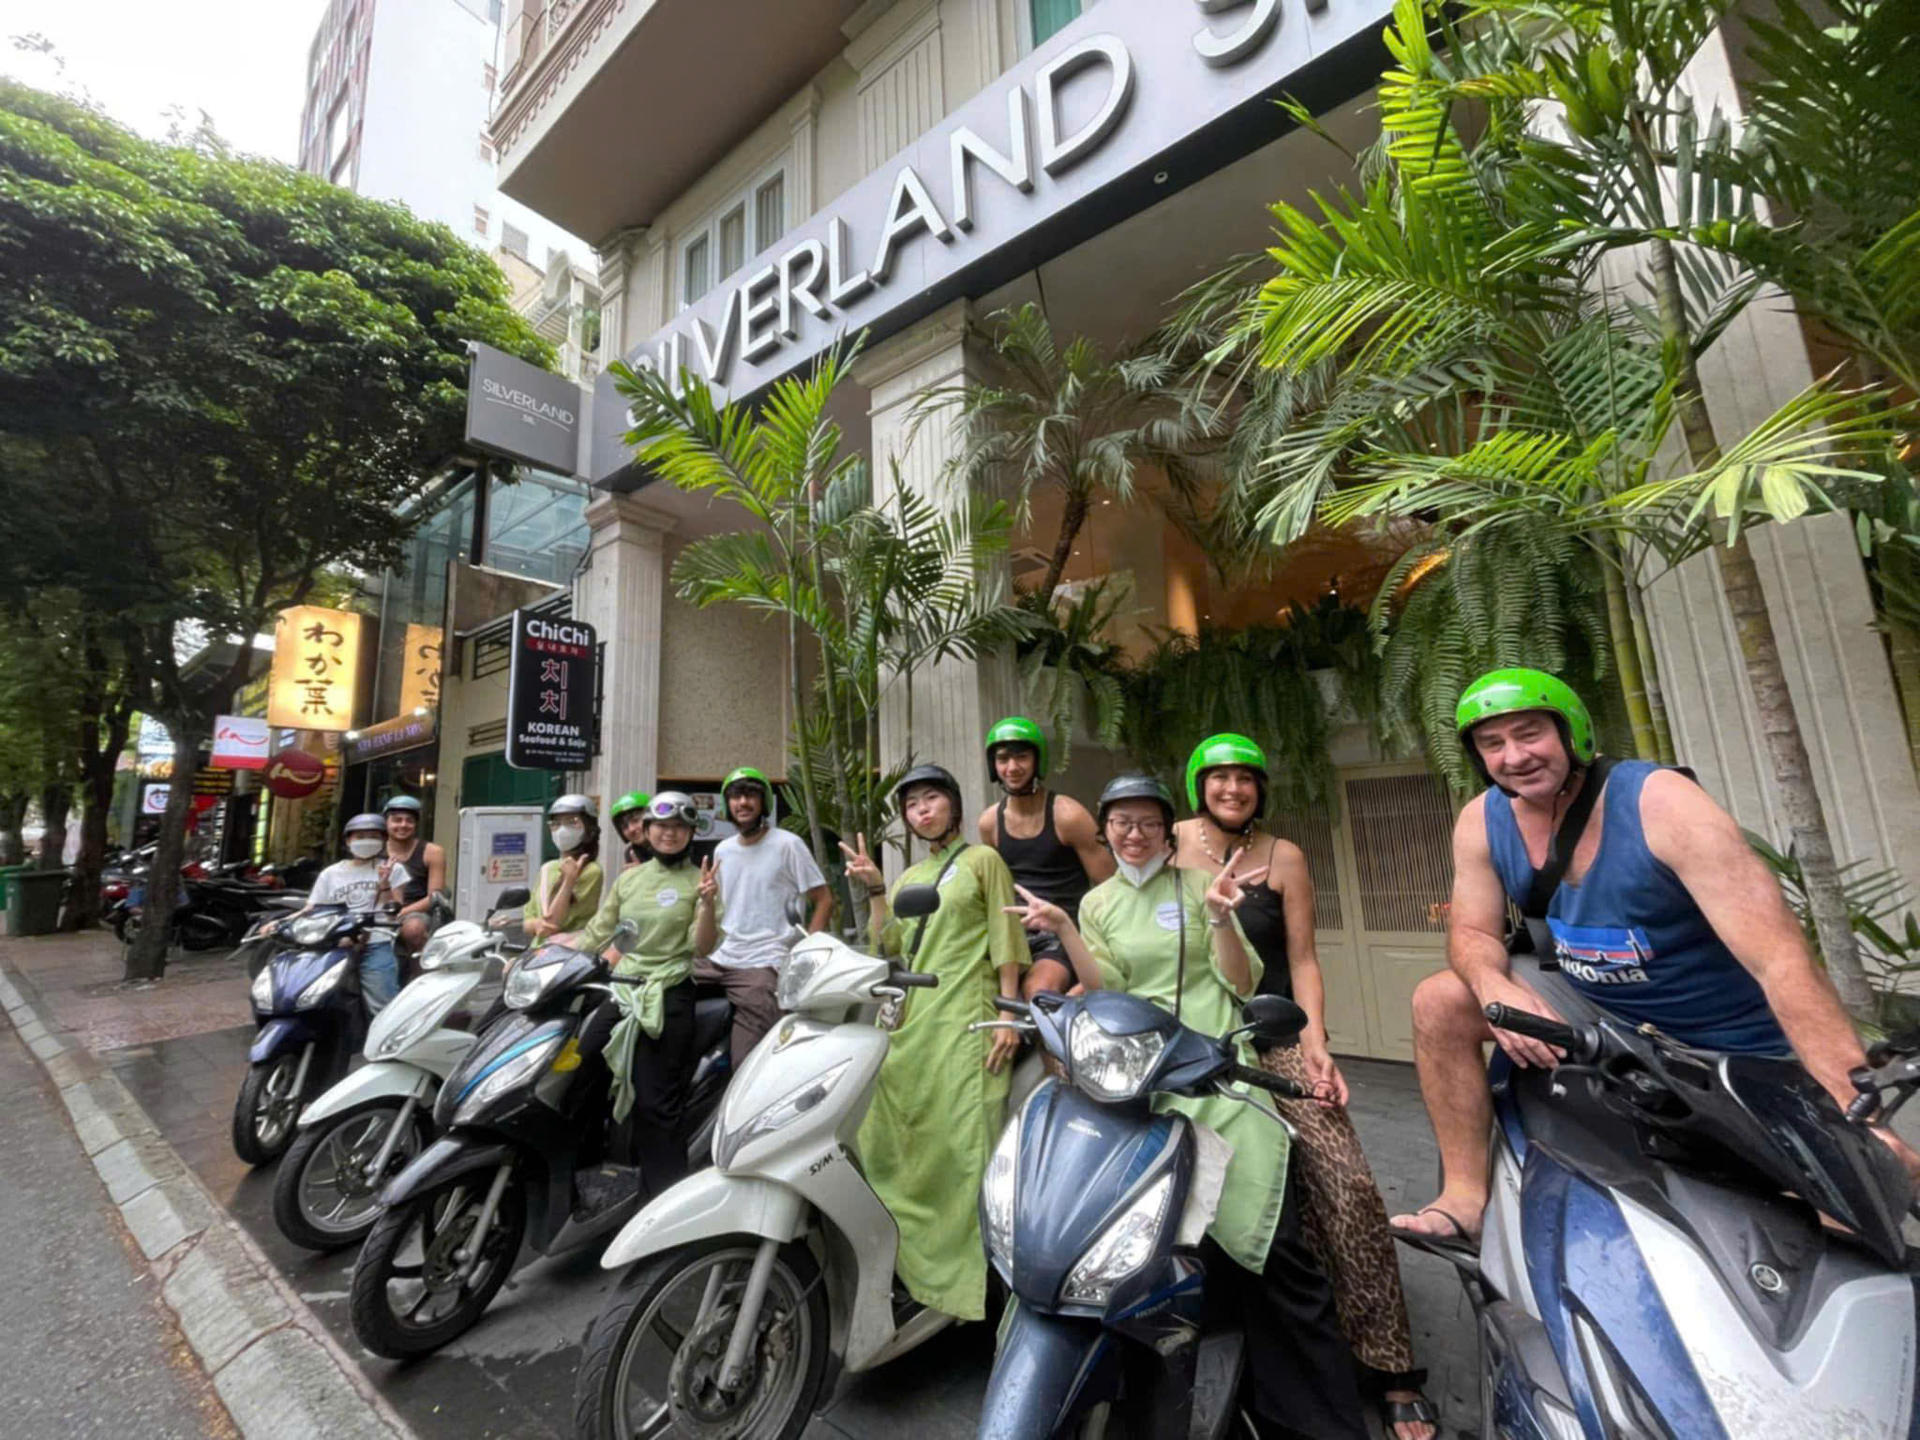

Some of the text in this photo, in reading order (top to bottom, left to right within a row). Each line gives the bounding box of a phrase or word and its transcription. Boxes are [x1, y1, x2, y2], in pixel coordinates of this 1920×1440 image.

[482, 378, 574, 425] SILVERLAND
[526, 619, 589, 646] ChiChi
[294, 621, 344, 715] わか葉
[518, 733, 557, 746] Seafood
[527, 721, 580, 736] KOREAN
[809, 1152, 834, 1177] SYM
